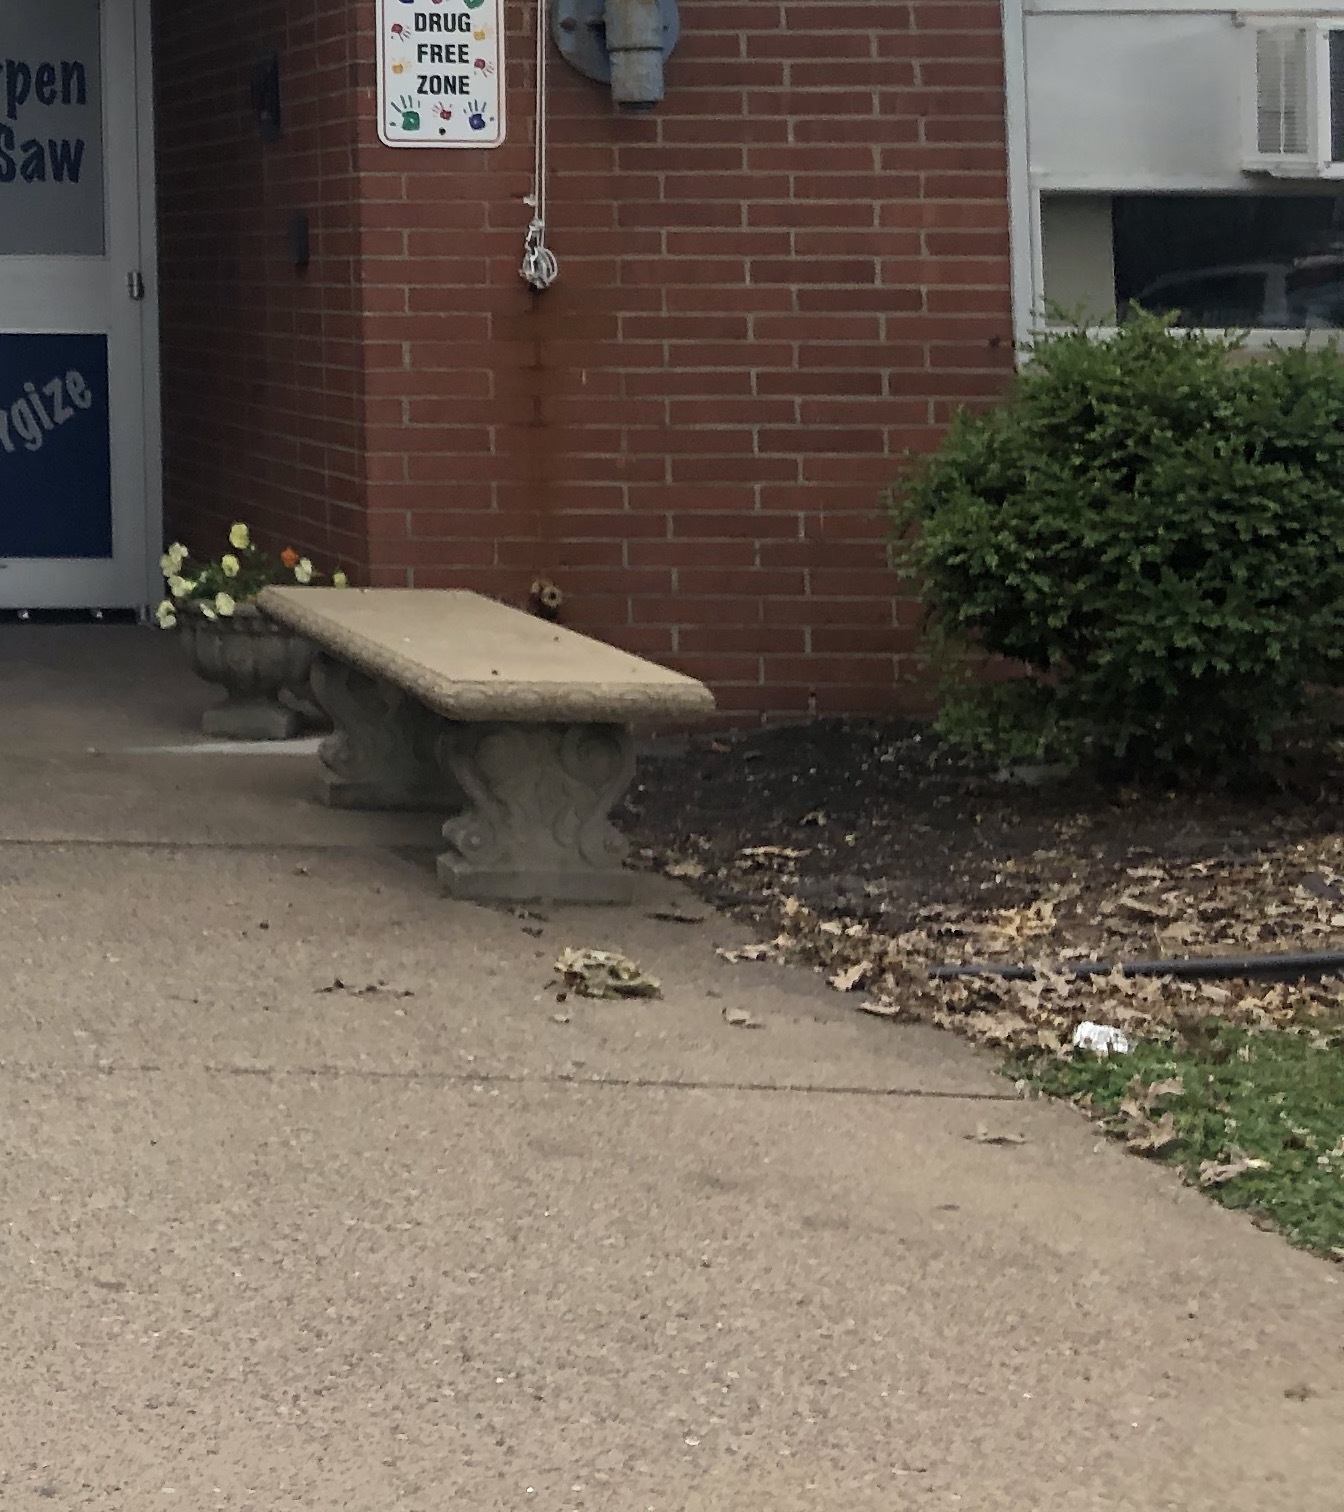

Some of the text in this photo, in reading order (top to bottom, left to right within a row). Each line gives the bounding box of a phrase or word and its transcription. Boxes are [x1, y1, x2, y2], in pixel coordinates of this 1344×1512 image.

[414, 12, 472, 33] DRUG
[416, 43, 470, 64] FREE
[416, 75, 470, 95] ZONE
